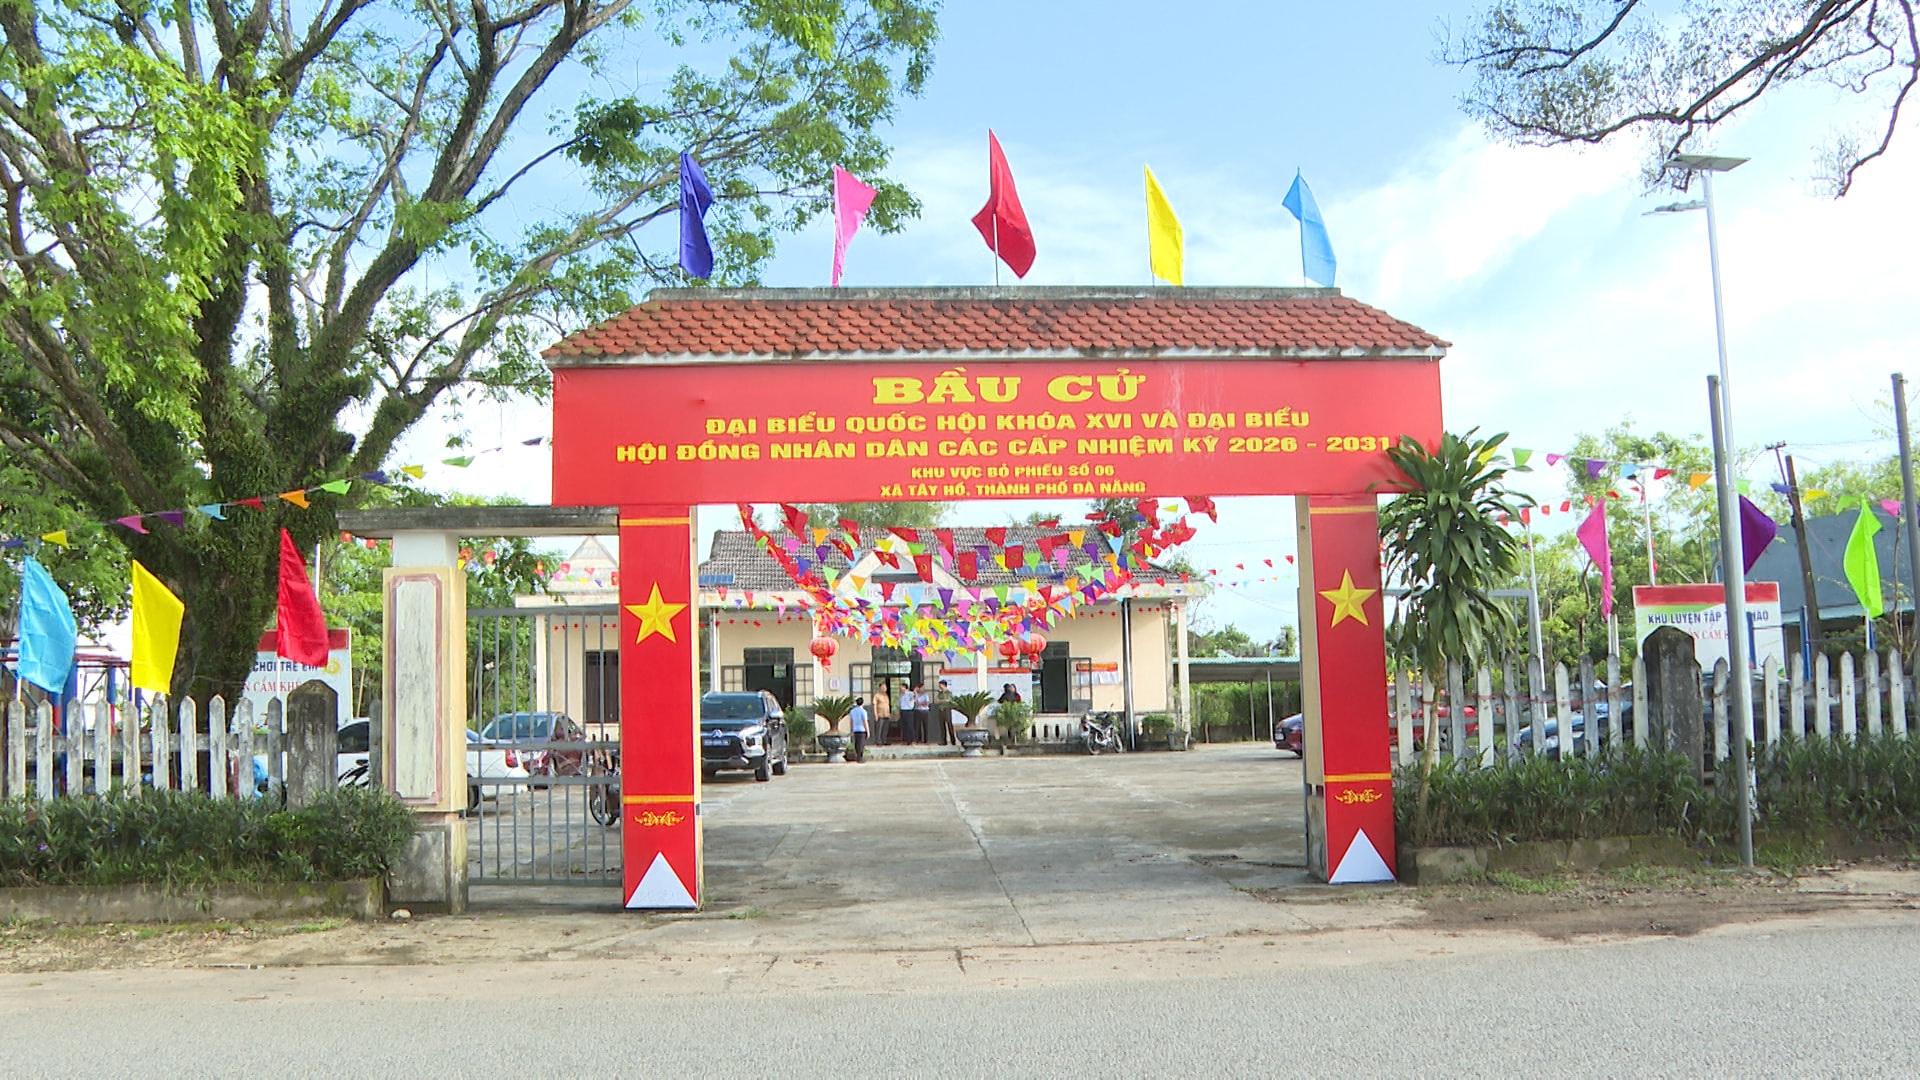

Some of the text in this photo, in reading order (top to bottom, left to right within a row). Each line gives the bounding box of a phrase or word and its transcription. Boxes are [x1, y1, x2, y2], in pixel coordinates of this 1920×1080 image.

[872, 366, 1147, 405] BẦU CỬ
[705, 406, 1310, 438] ĐẠI BIỂU QUỐC HỘI KHÓA XVI VÀ ĐẠI BIỂU
[616, 442, 667, 465] HỘI
[676, 439, 760, 461] ĐỒNG
[770, 439, 856, 459] NHÂN
[866, 438, 929, 458] DÂN
[938, 437, 998, 456] CÁC
[1008, 434, 1068, 455] CẤP
[1077, 435, 1174, 458] NHIỆM
[1228, 436, 1298, 453] 2026
[1326, 436, 1391, 452] 2031
[911, 461, 1115, 480] KHU VỰC BỎ PHIẾU SỐ 06
[880, 483, 904, 497] XÃ
[907, 482, 939, 496] TÂY
[974, 480, 1031, 496] THÀNH
[1034, 479, 1069, 495] PHỐ
[1072, 481, 1096, 494] ĐÀ
[1648, 614, 1668, 624] KHU
